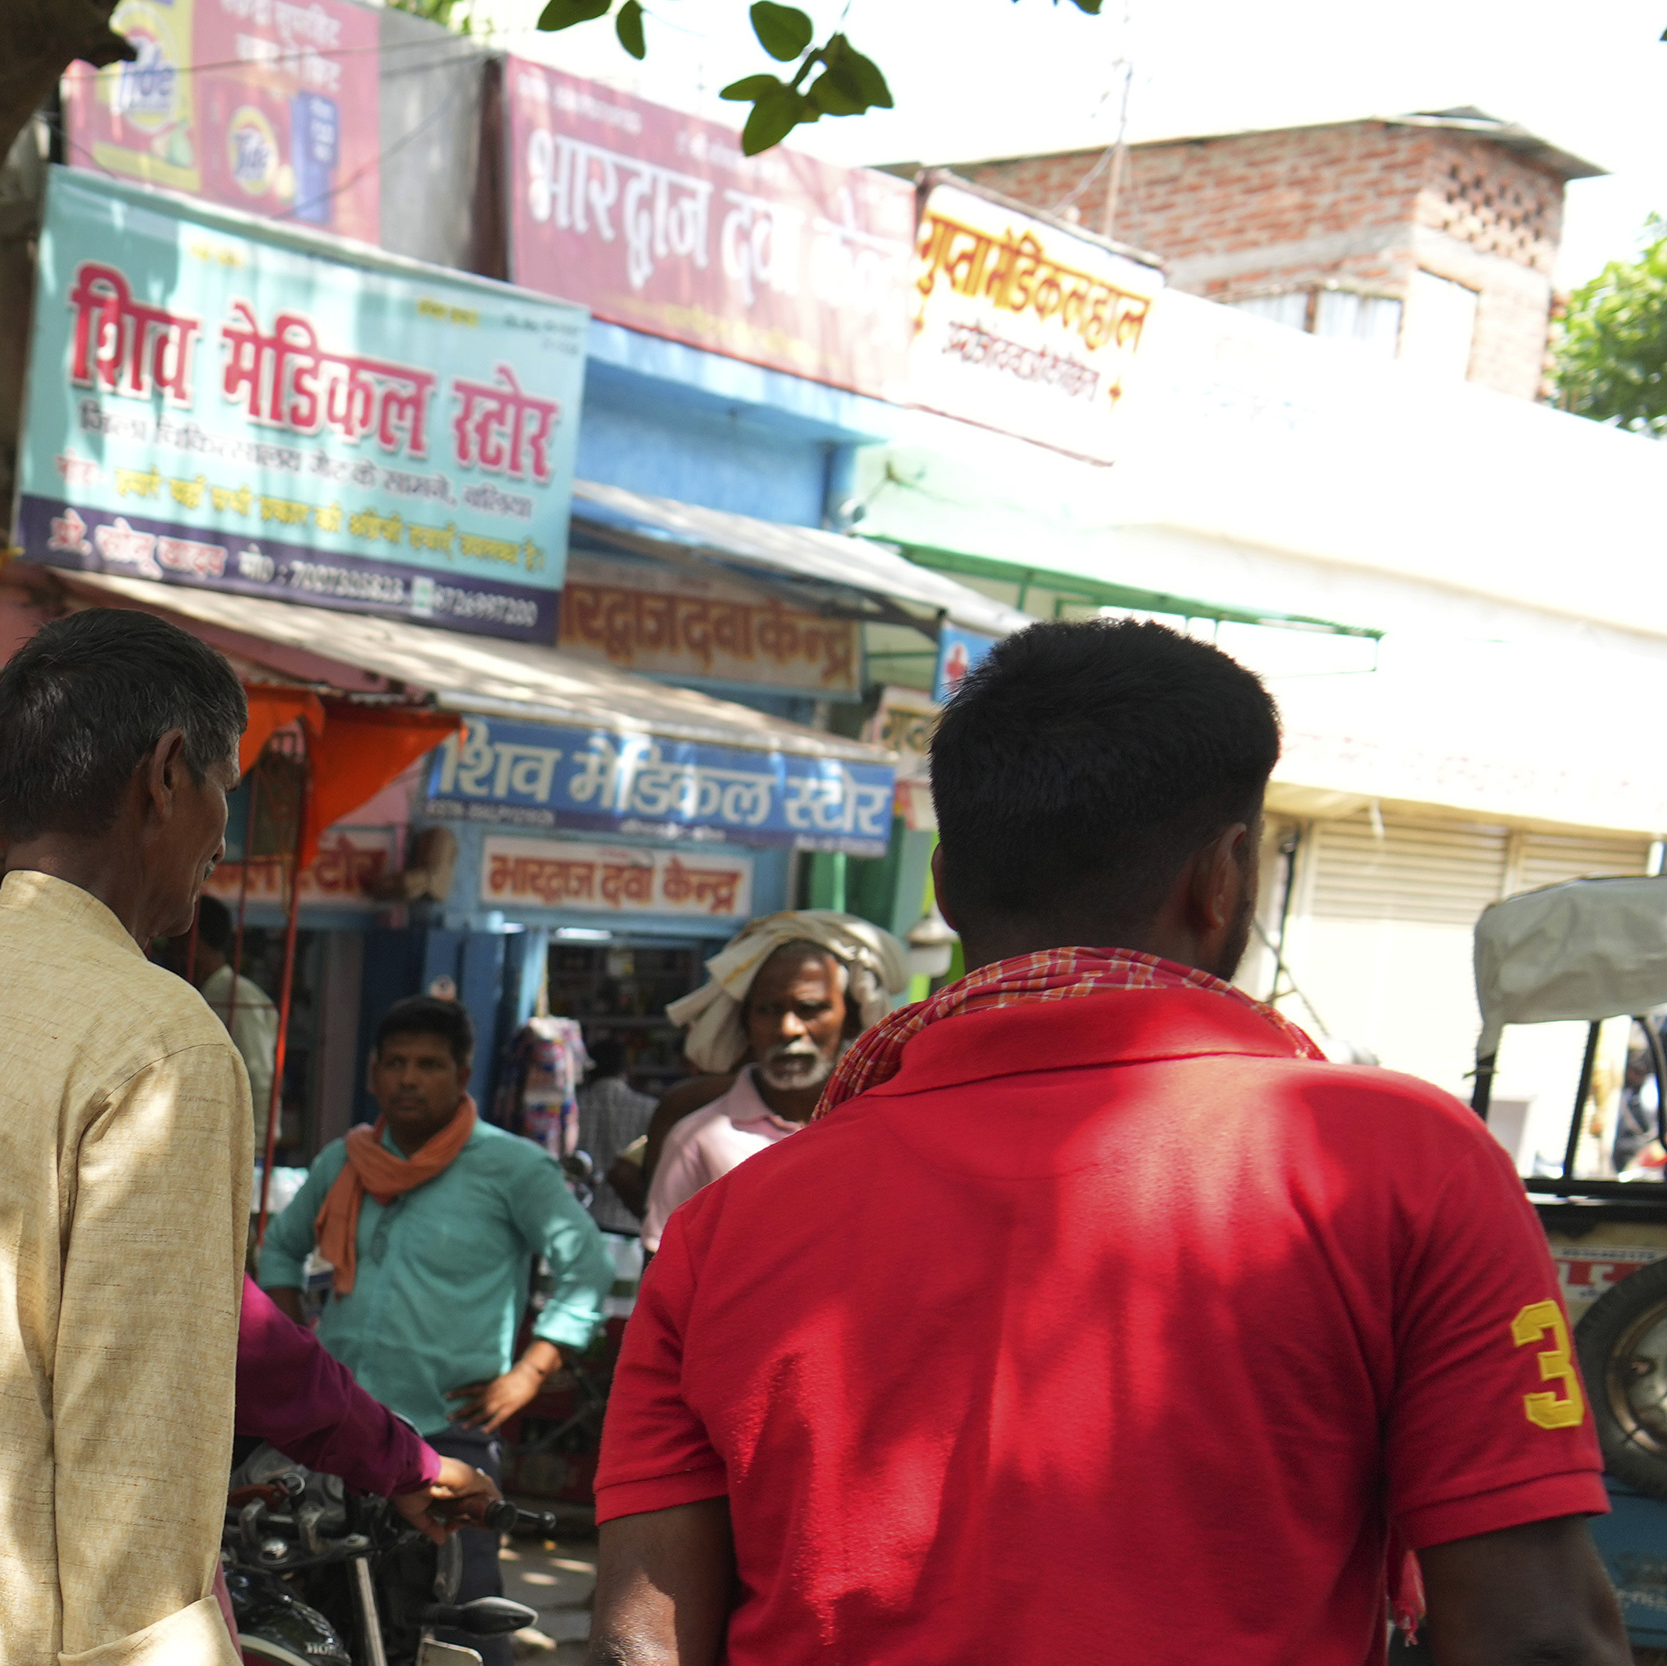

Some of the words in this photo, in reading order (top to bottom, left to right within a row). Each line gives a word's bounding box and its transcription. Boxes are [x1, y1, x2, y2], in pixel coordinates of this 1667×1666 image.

[70, 262, 202, 409] शिव
[220, 296, 436, 460] मेडिकल
[451, 362, 561, 483] स्टोर
[436, 717, 563, 803] शिव
[569, 731, 776, 828] मेडिकल
[783, 758, 892, 839] स्टोर
